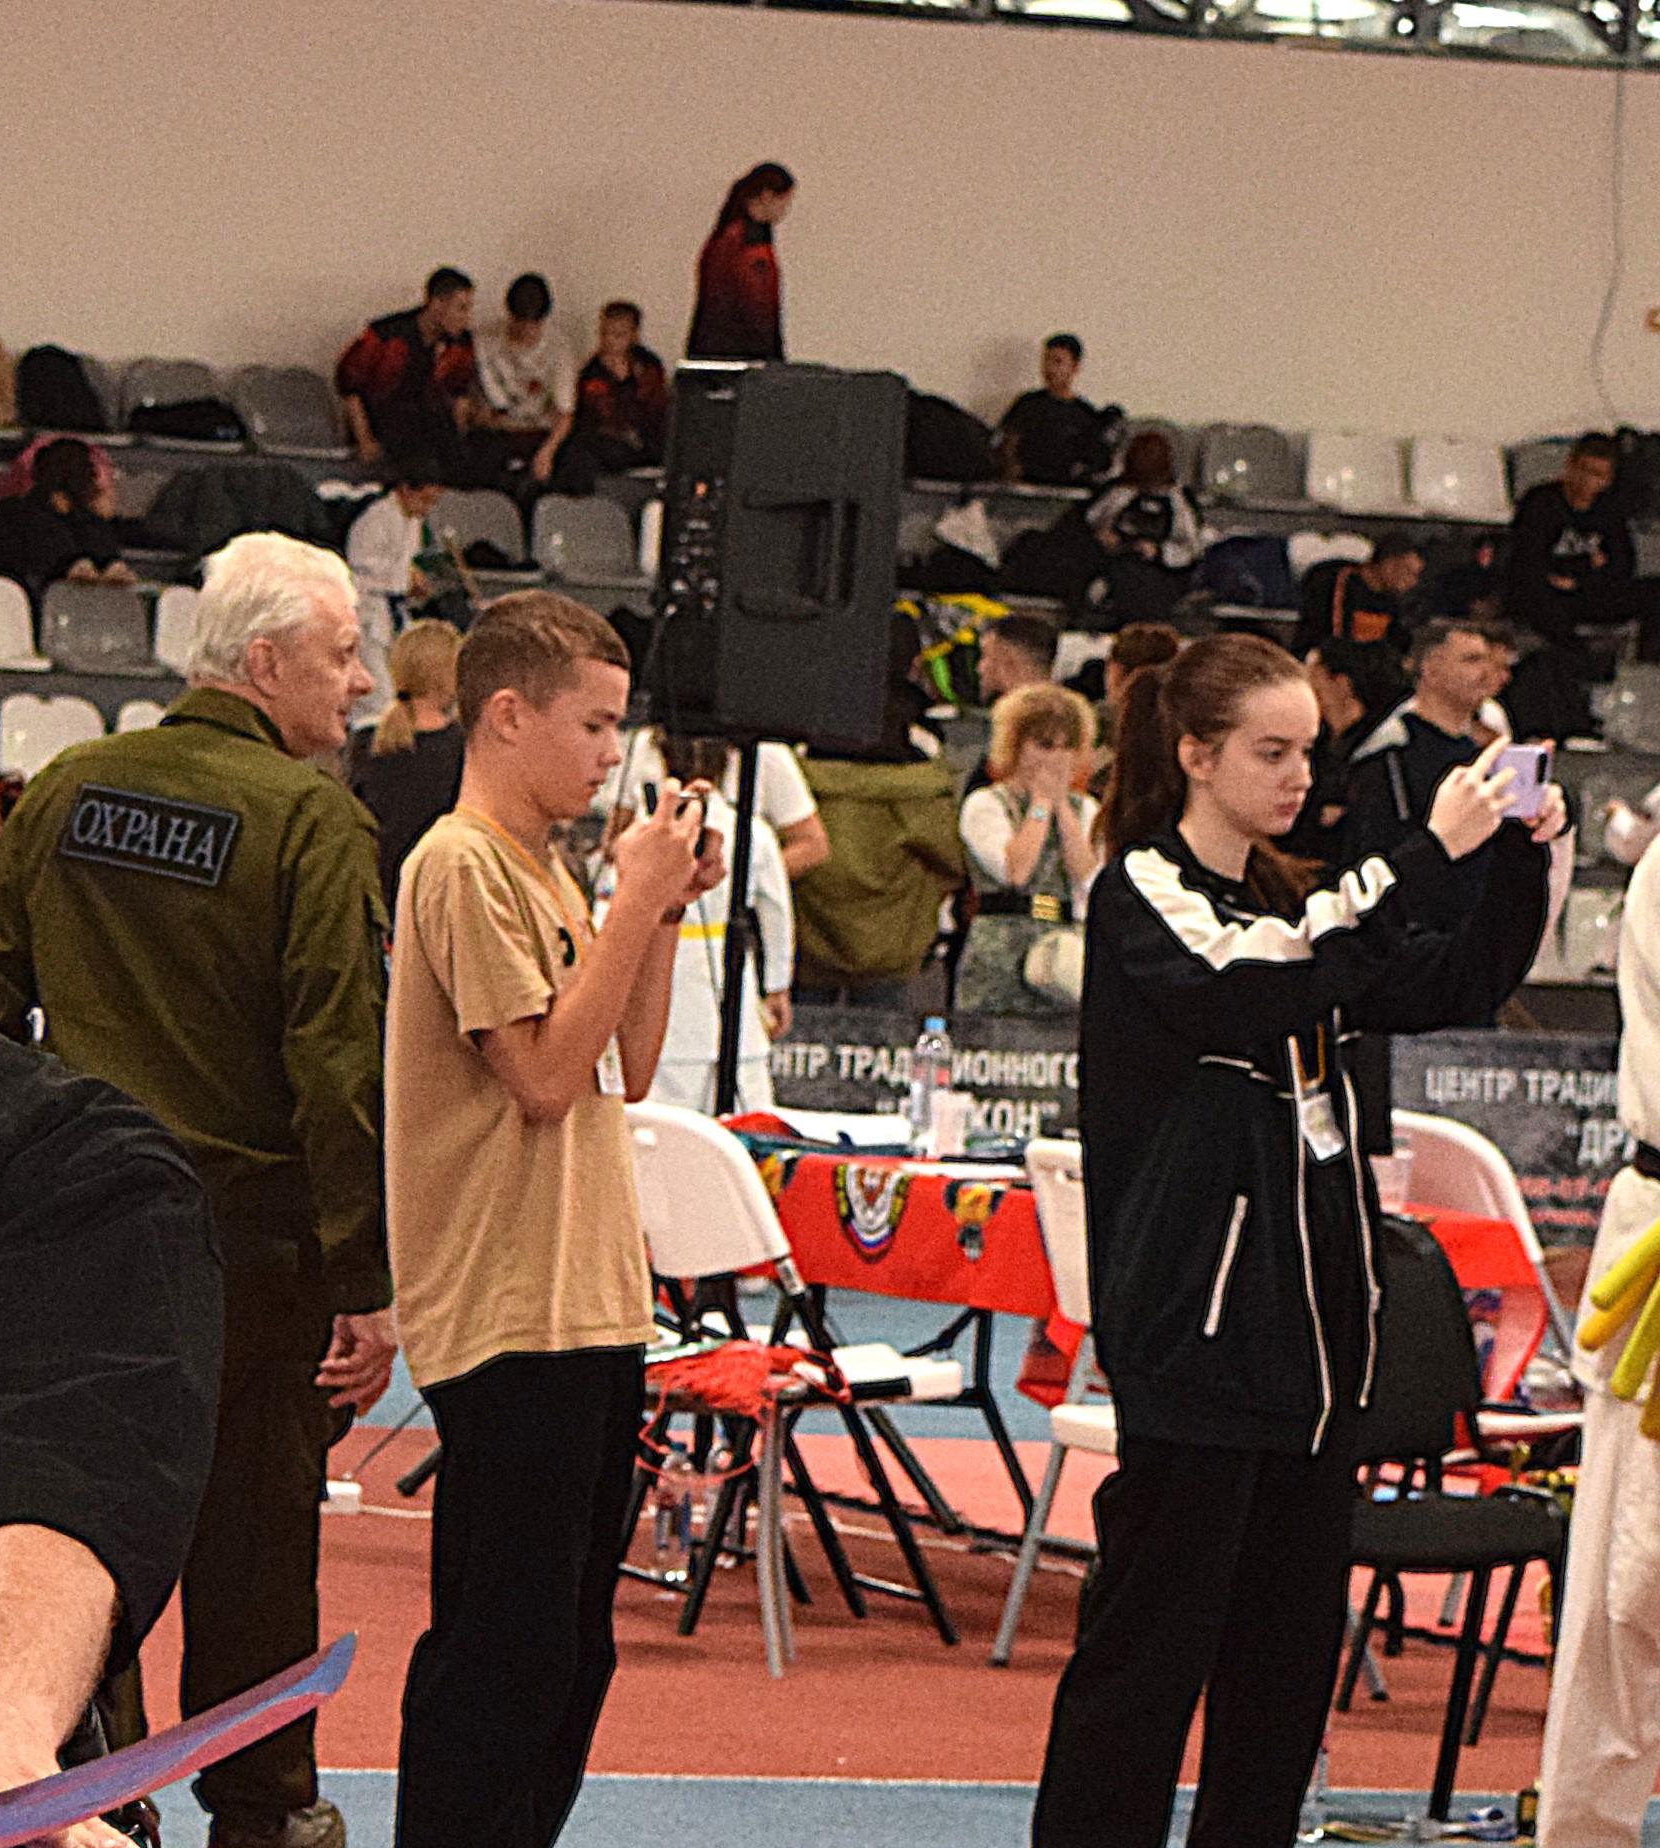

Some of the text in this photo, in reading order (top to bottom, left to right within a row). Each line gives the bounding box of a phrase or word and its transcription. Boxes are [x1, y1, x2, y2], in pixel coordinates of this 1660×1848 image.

[72, 800, 216, 869] ОХРАНА
[771, 1043, 830, 1079] НТР
[1425, 1065, 1518, 1102] ЦЕНТР
